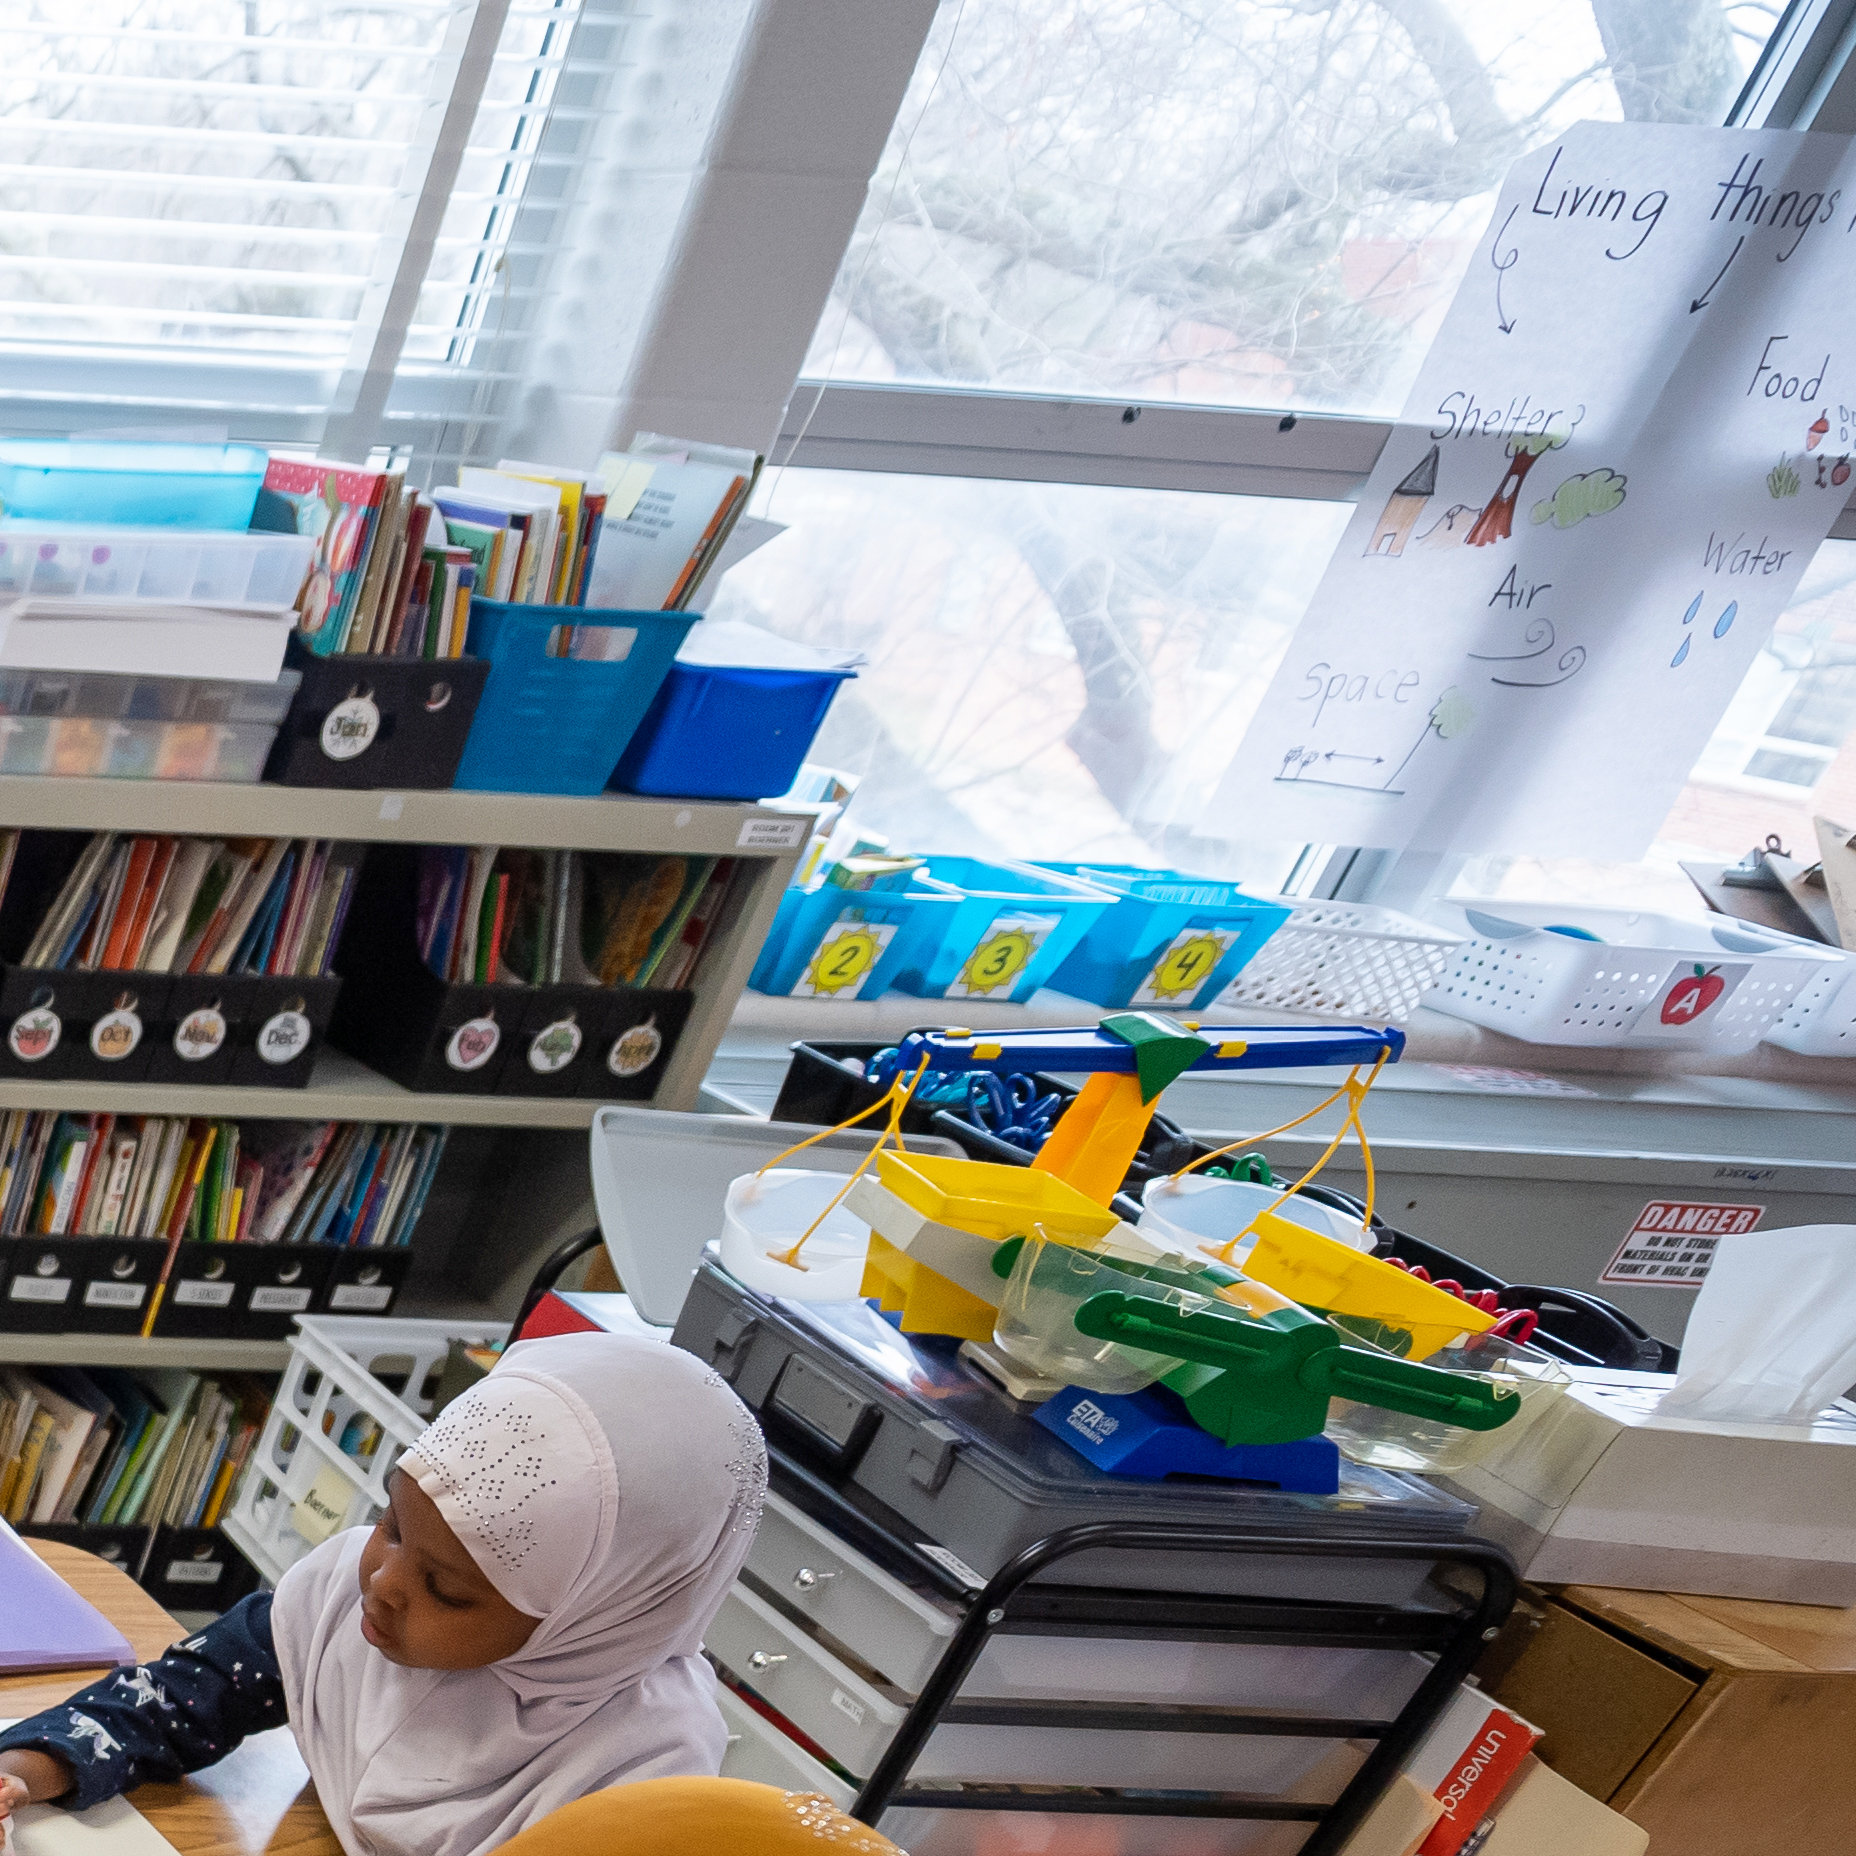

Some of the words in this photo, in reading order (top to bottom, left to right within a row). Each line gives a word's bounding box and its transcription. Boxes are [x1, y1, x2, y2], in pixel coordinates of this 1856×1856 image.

[1532, 145, 1670, 260] Living
[1710, 152, 1841, 263] things
[1747, 335, 1831, 402] Food
[1702, 531, 1793, 577] Water
[1488, 563, 1552, 610] Air
[1297, 662, 1421, 729] Space
[828, 944, 860, 977] 2
[982, 943, 1014, 976] 3
[1174, 946, 1205, 981] 4
[1668, 986, 1700, 1016] A
[1639, 1205, 1756, 1234] DANGER
[1621, 1249, 1679, 1262] MATERIALS
[1645, 1235, 1663, 1247] DO
[1662, 1236, 1686, 1248] NOT
[1613, 1262, 1645, 1275] FRONT
[1645, 1264, 1662, 1276] OF
[304, 1488, 341, 1521] Boerner
[1438, 1727, 1506, 1822] universal
